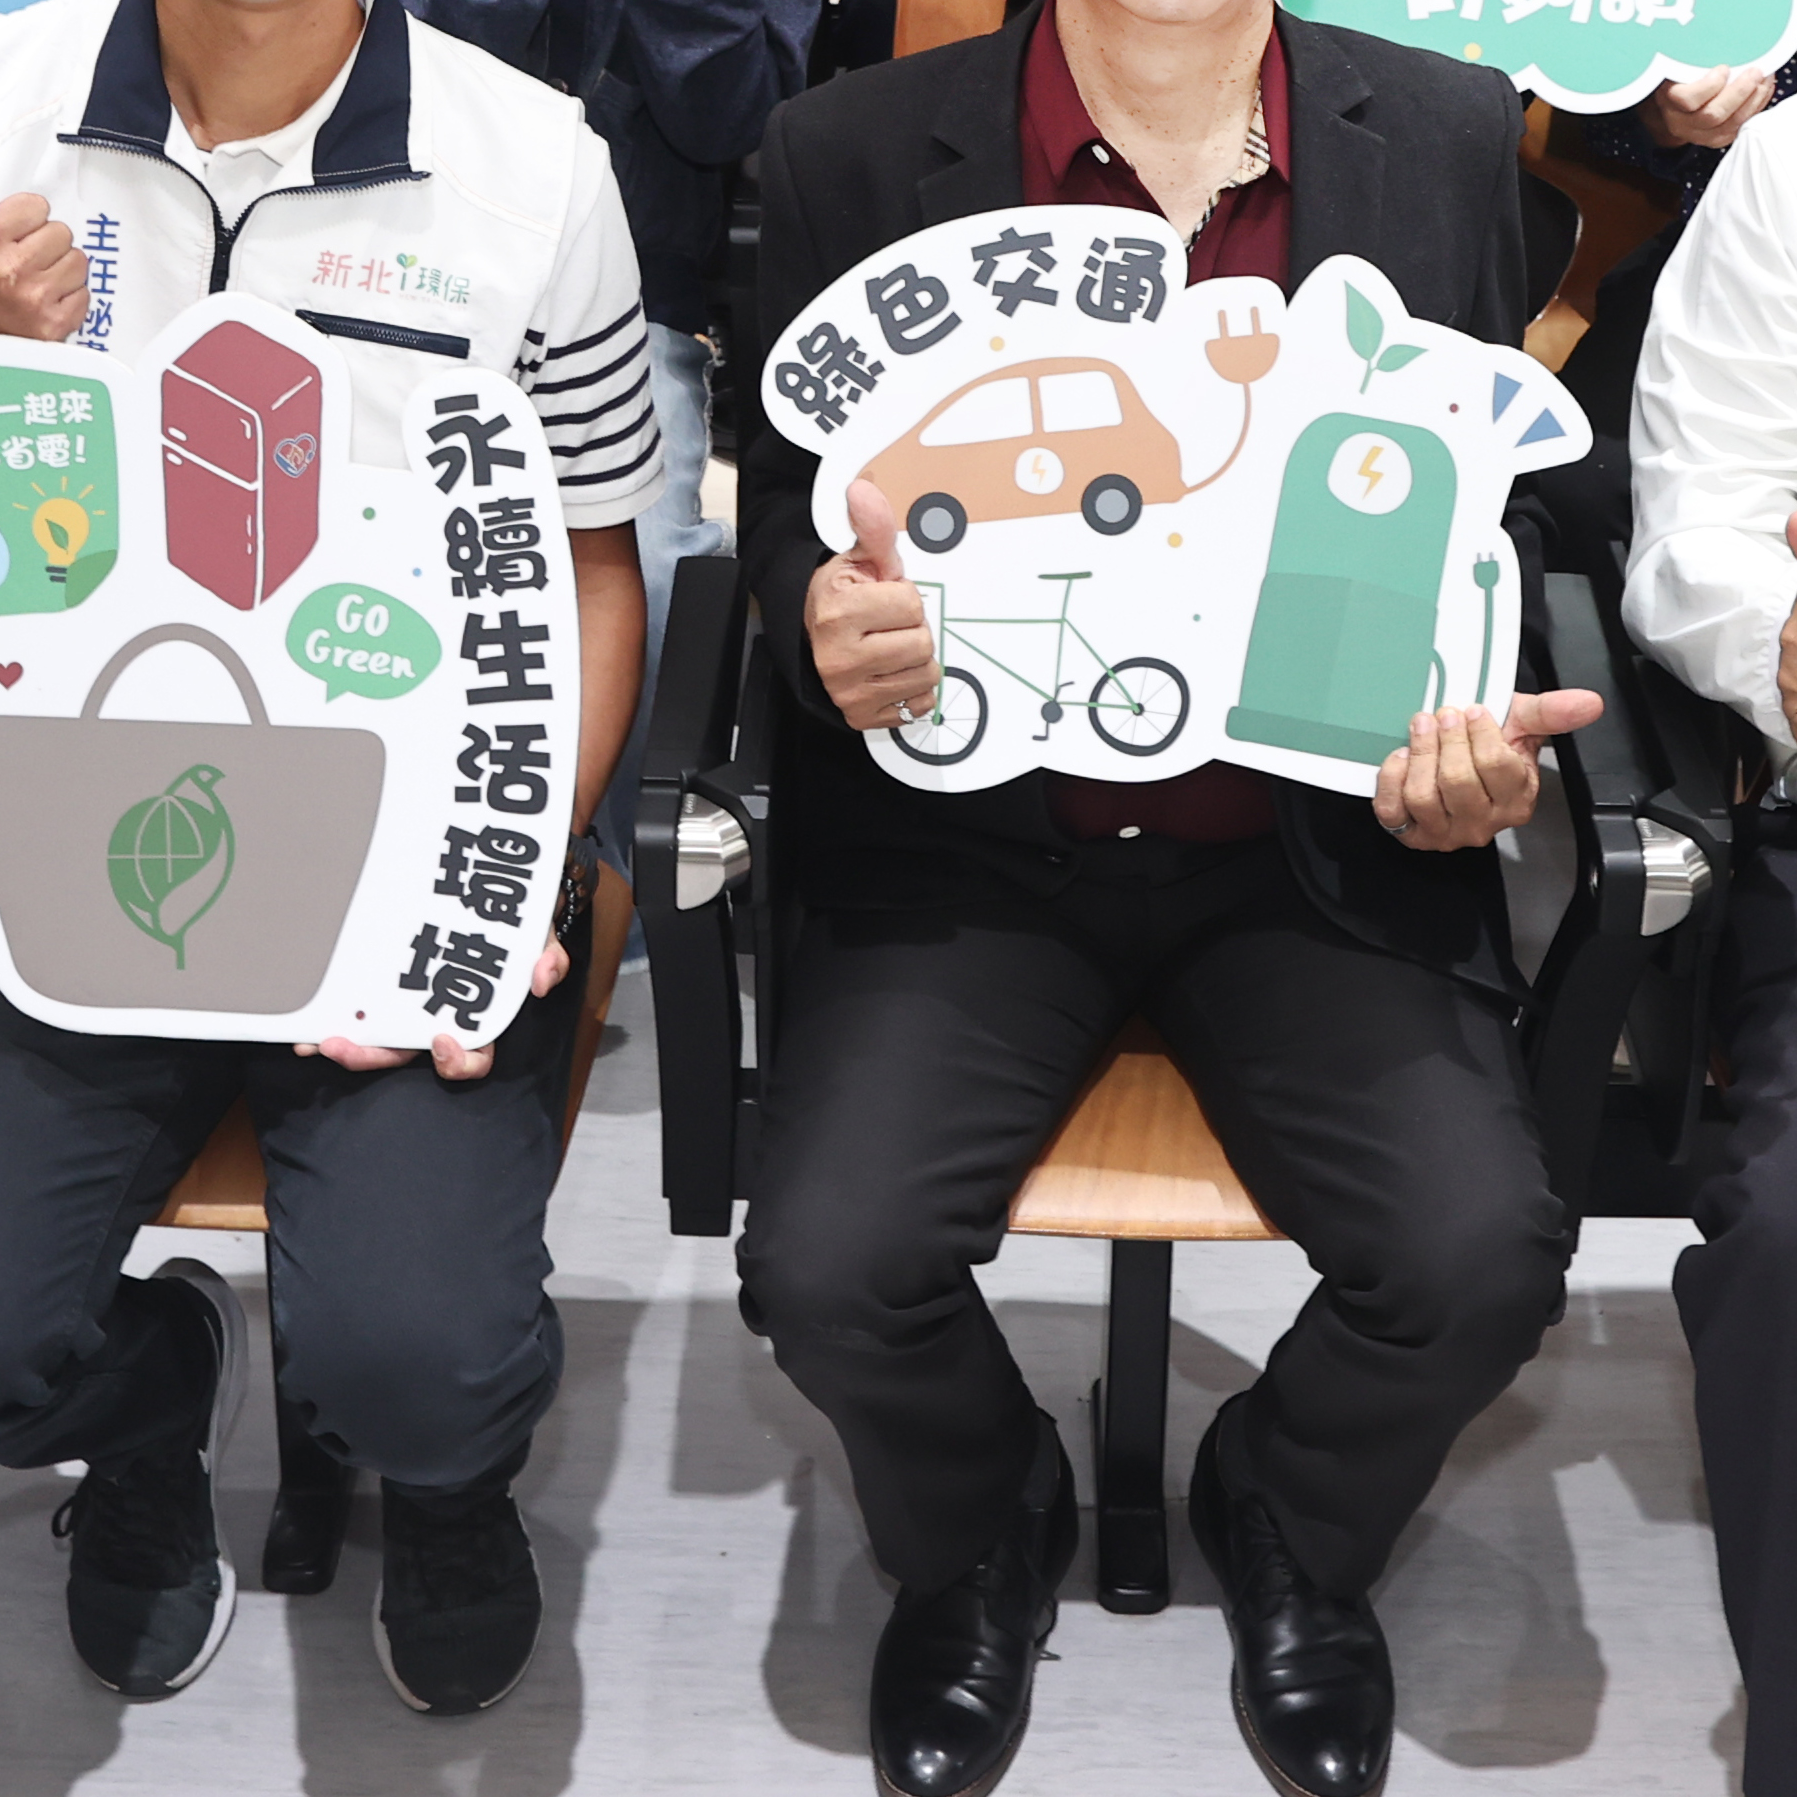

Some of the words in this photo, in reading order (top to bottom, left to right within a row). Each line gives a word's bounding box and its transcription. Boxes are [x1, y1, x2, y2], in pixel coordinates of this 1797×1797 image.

[775, 226, 1167, 434] 綠色交通
[305, 629, 416, 679] Green
[399, 394, 555, 1032] 永續生活環境
